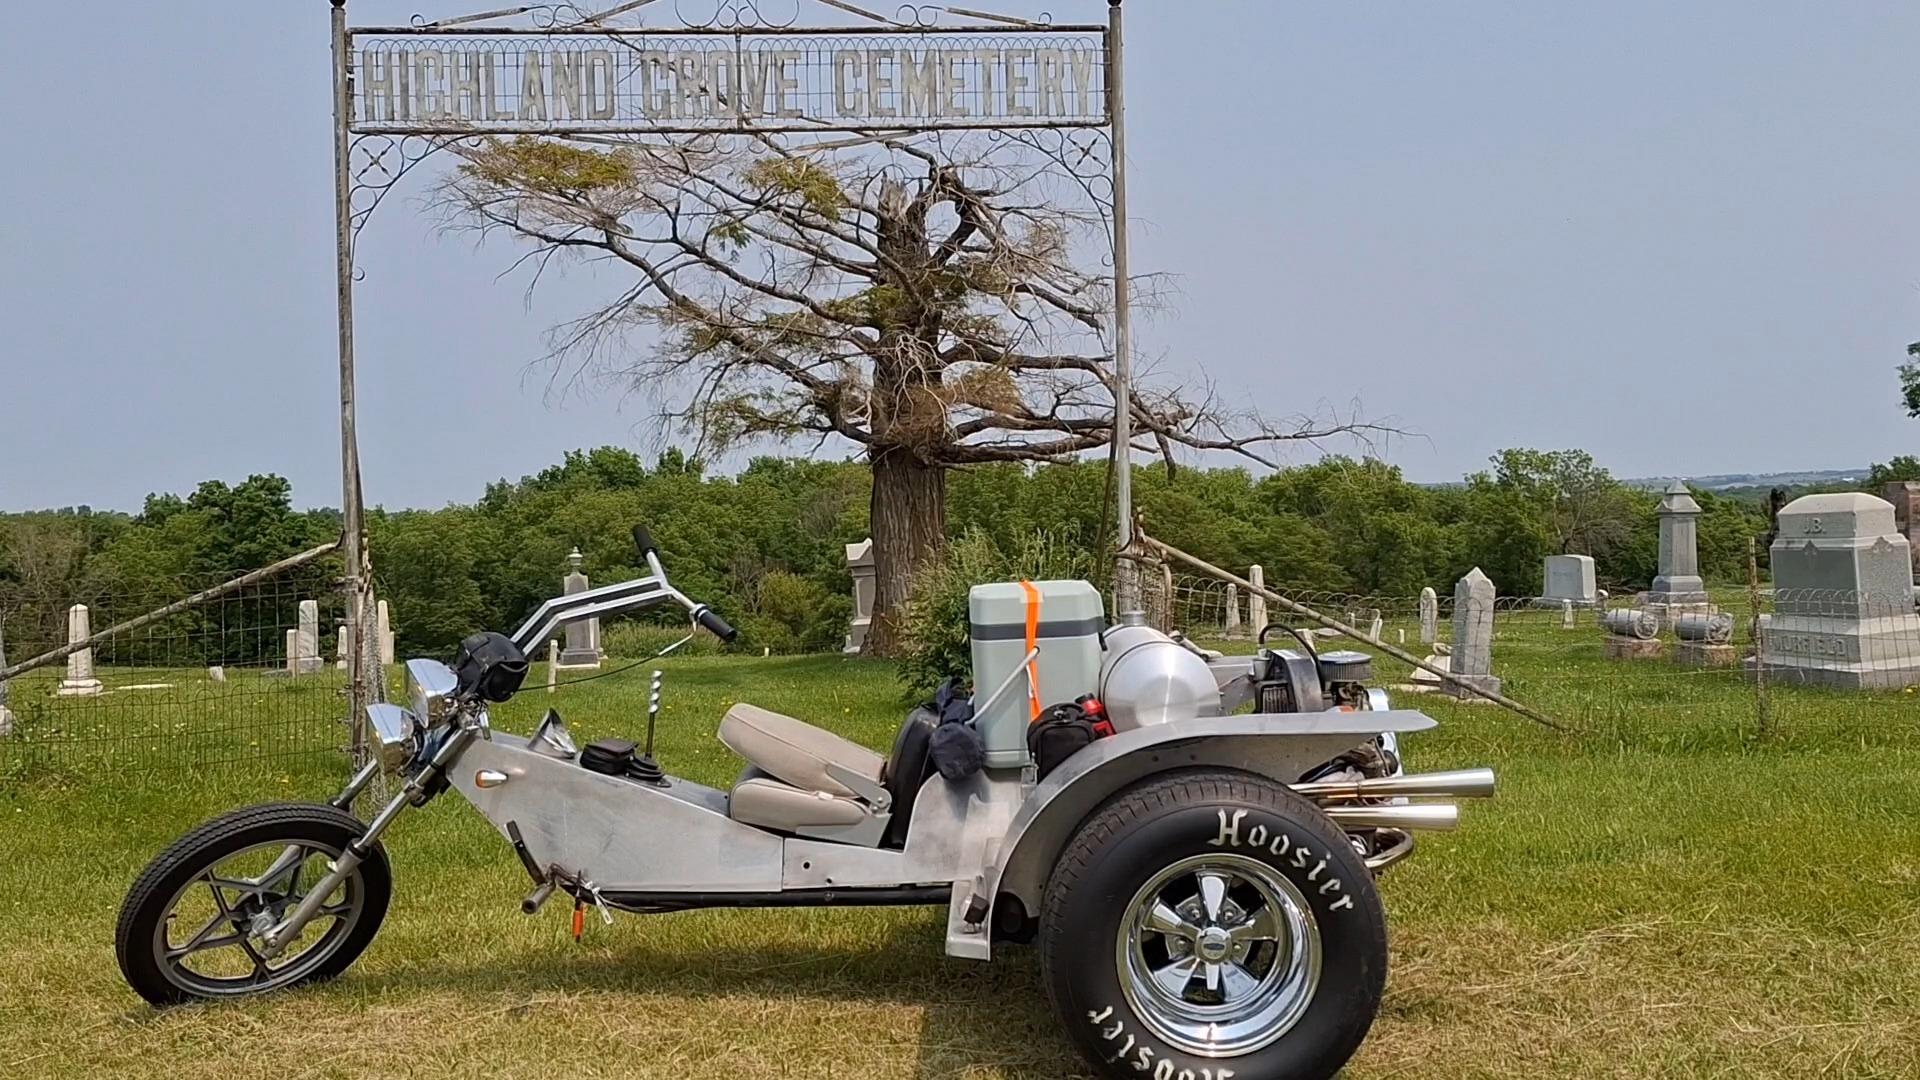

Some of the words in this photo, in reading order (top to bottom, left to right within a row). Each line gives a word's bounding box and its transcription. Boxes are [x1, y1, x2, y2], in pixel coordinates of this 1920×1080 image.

[363, 48, 615, 121] HIGHLAND
[640, 48, 803, 120] GROVE
[834, 47, 1093, 118] CEMETERY
[1207, 808, 1353, 912] Hoosier
